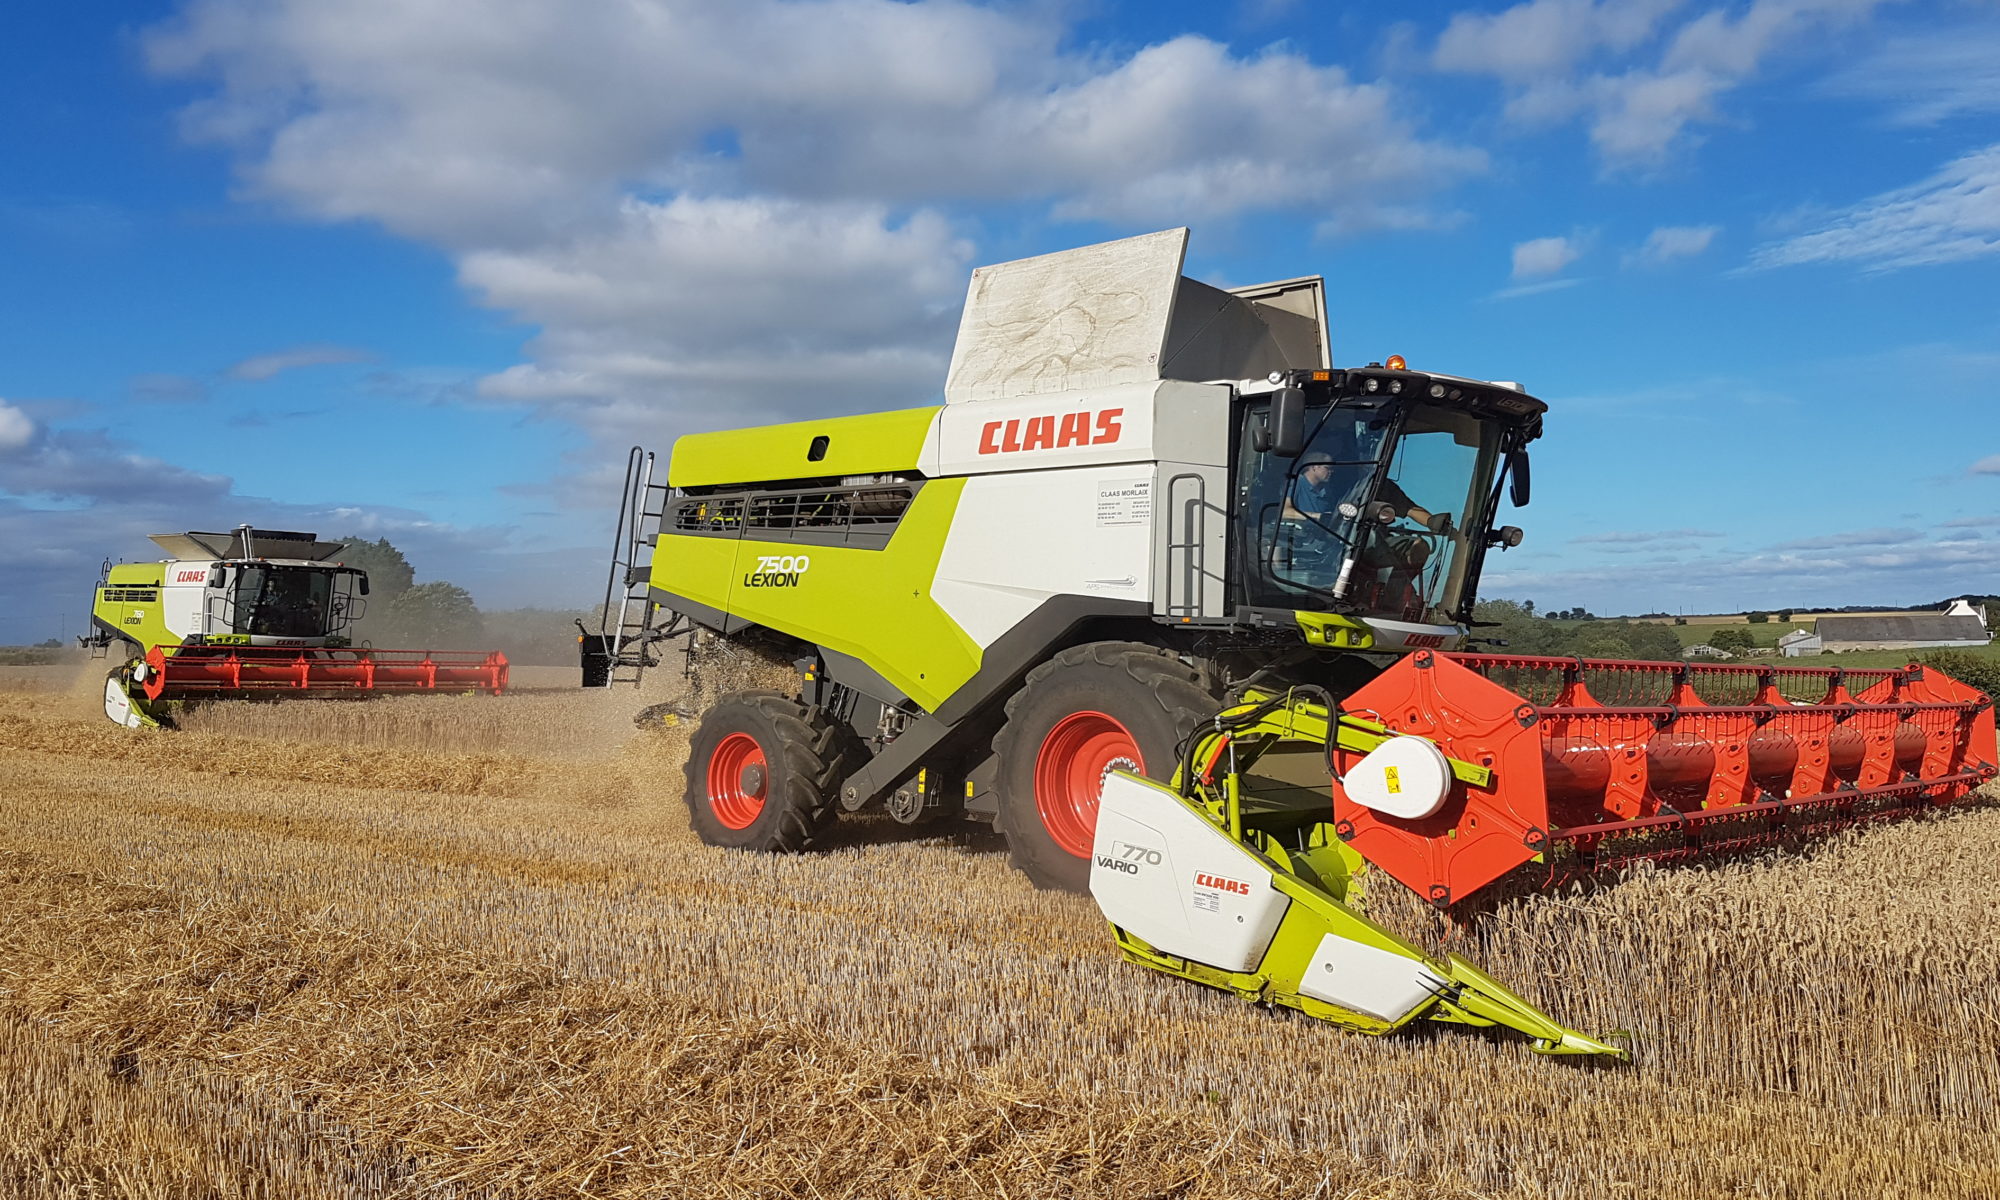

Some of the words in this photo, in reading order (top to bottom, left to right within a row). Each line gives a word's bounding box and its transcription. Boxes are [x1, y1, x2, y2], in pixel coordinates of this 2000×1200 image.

[978, 408, 1124, 455] CLAAS
[1100, 490, 1120, 498] CLAAS
[755, 555, 810, 574] 7500
[176, 571, 207, 582] CLAAS
[744, 572, 800, 587] LEXION
[124, 616, 142, 625] LEXION
[1403, 633, 1446, 648] CLAAS
[1121, 844, 1162, 866] 770
[1097, 855, 1139, 875] VARIO
[1196, 873, 1250, 896] CLAAS
